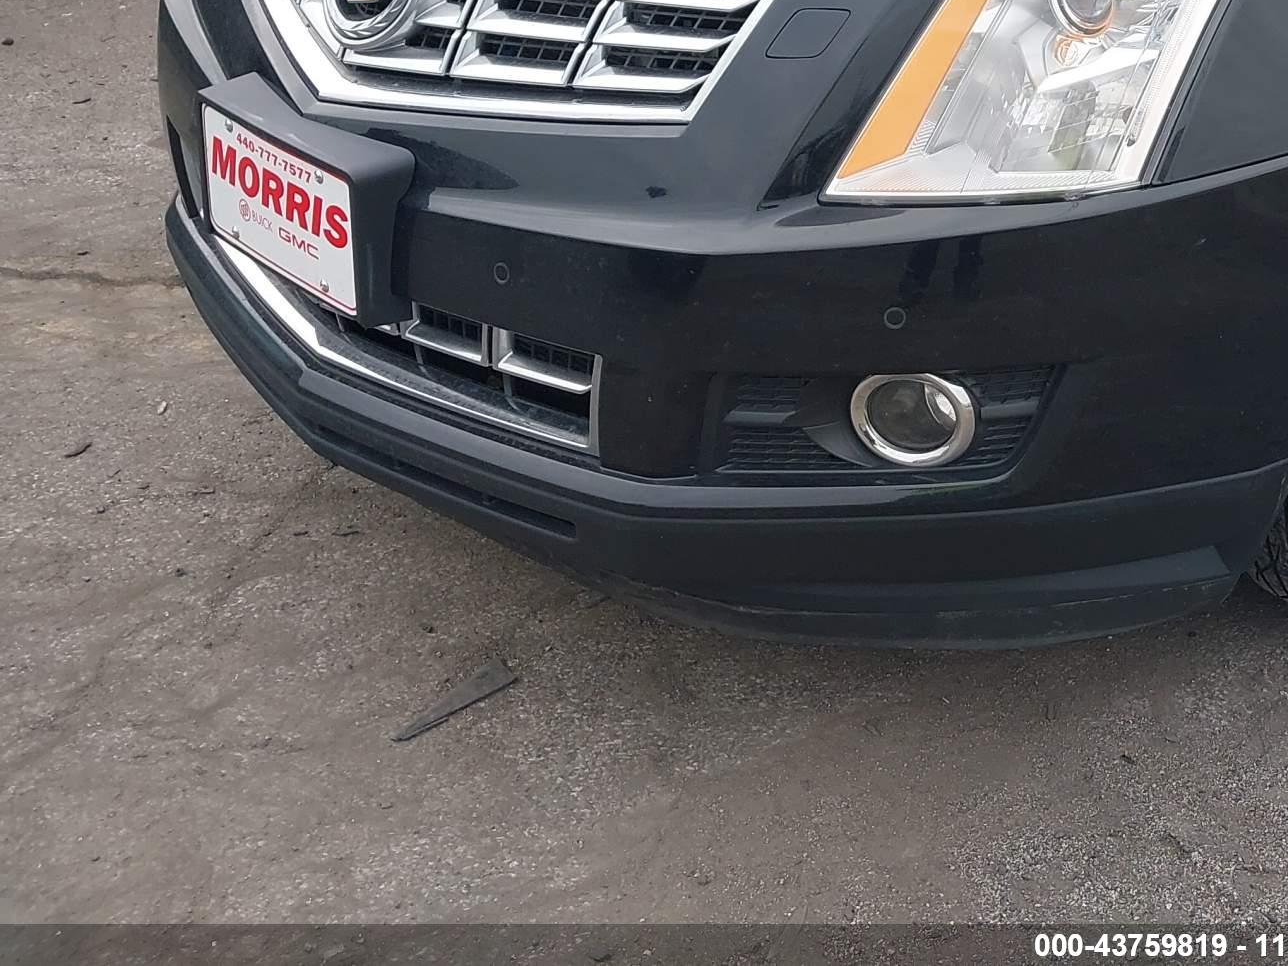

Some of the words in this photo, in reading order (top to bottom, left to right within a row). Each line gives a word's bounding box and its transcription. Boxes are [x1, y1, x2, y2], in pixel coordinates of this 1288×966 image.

[236, 133, 312, 183] 440-777-7577
[212, 137, 348, 248] MORRIS
[252, 210, 273, 232] BUICK
[278, 227, 319, 260] GMC
